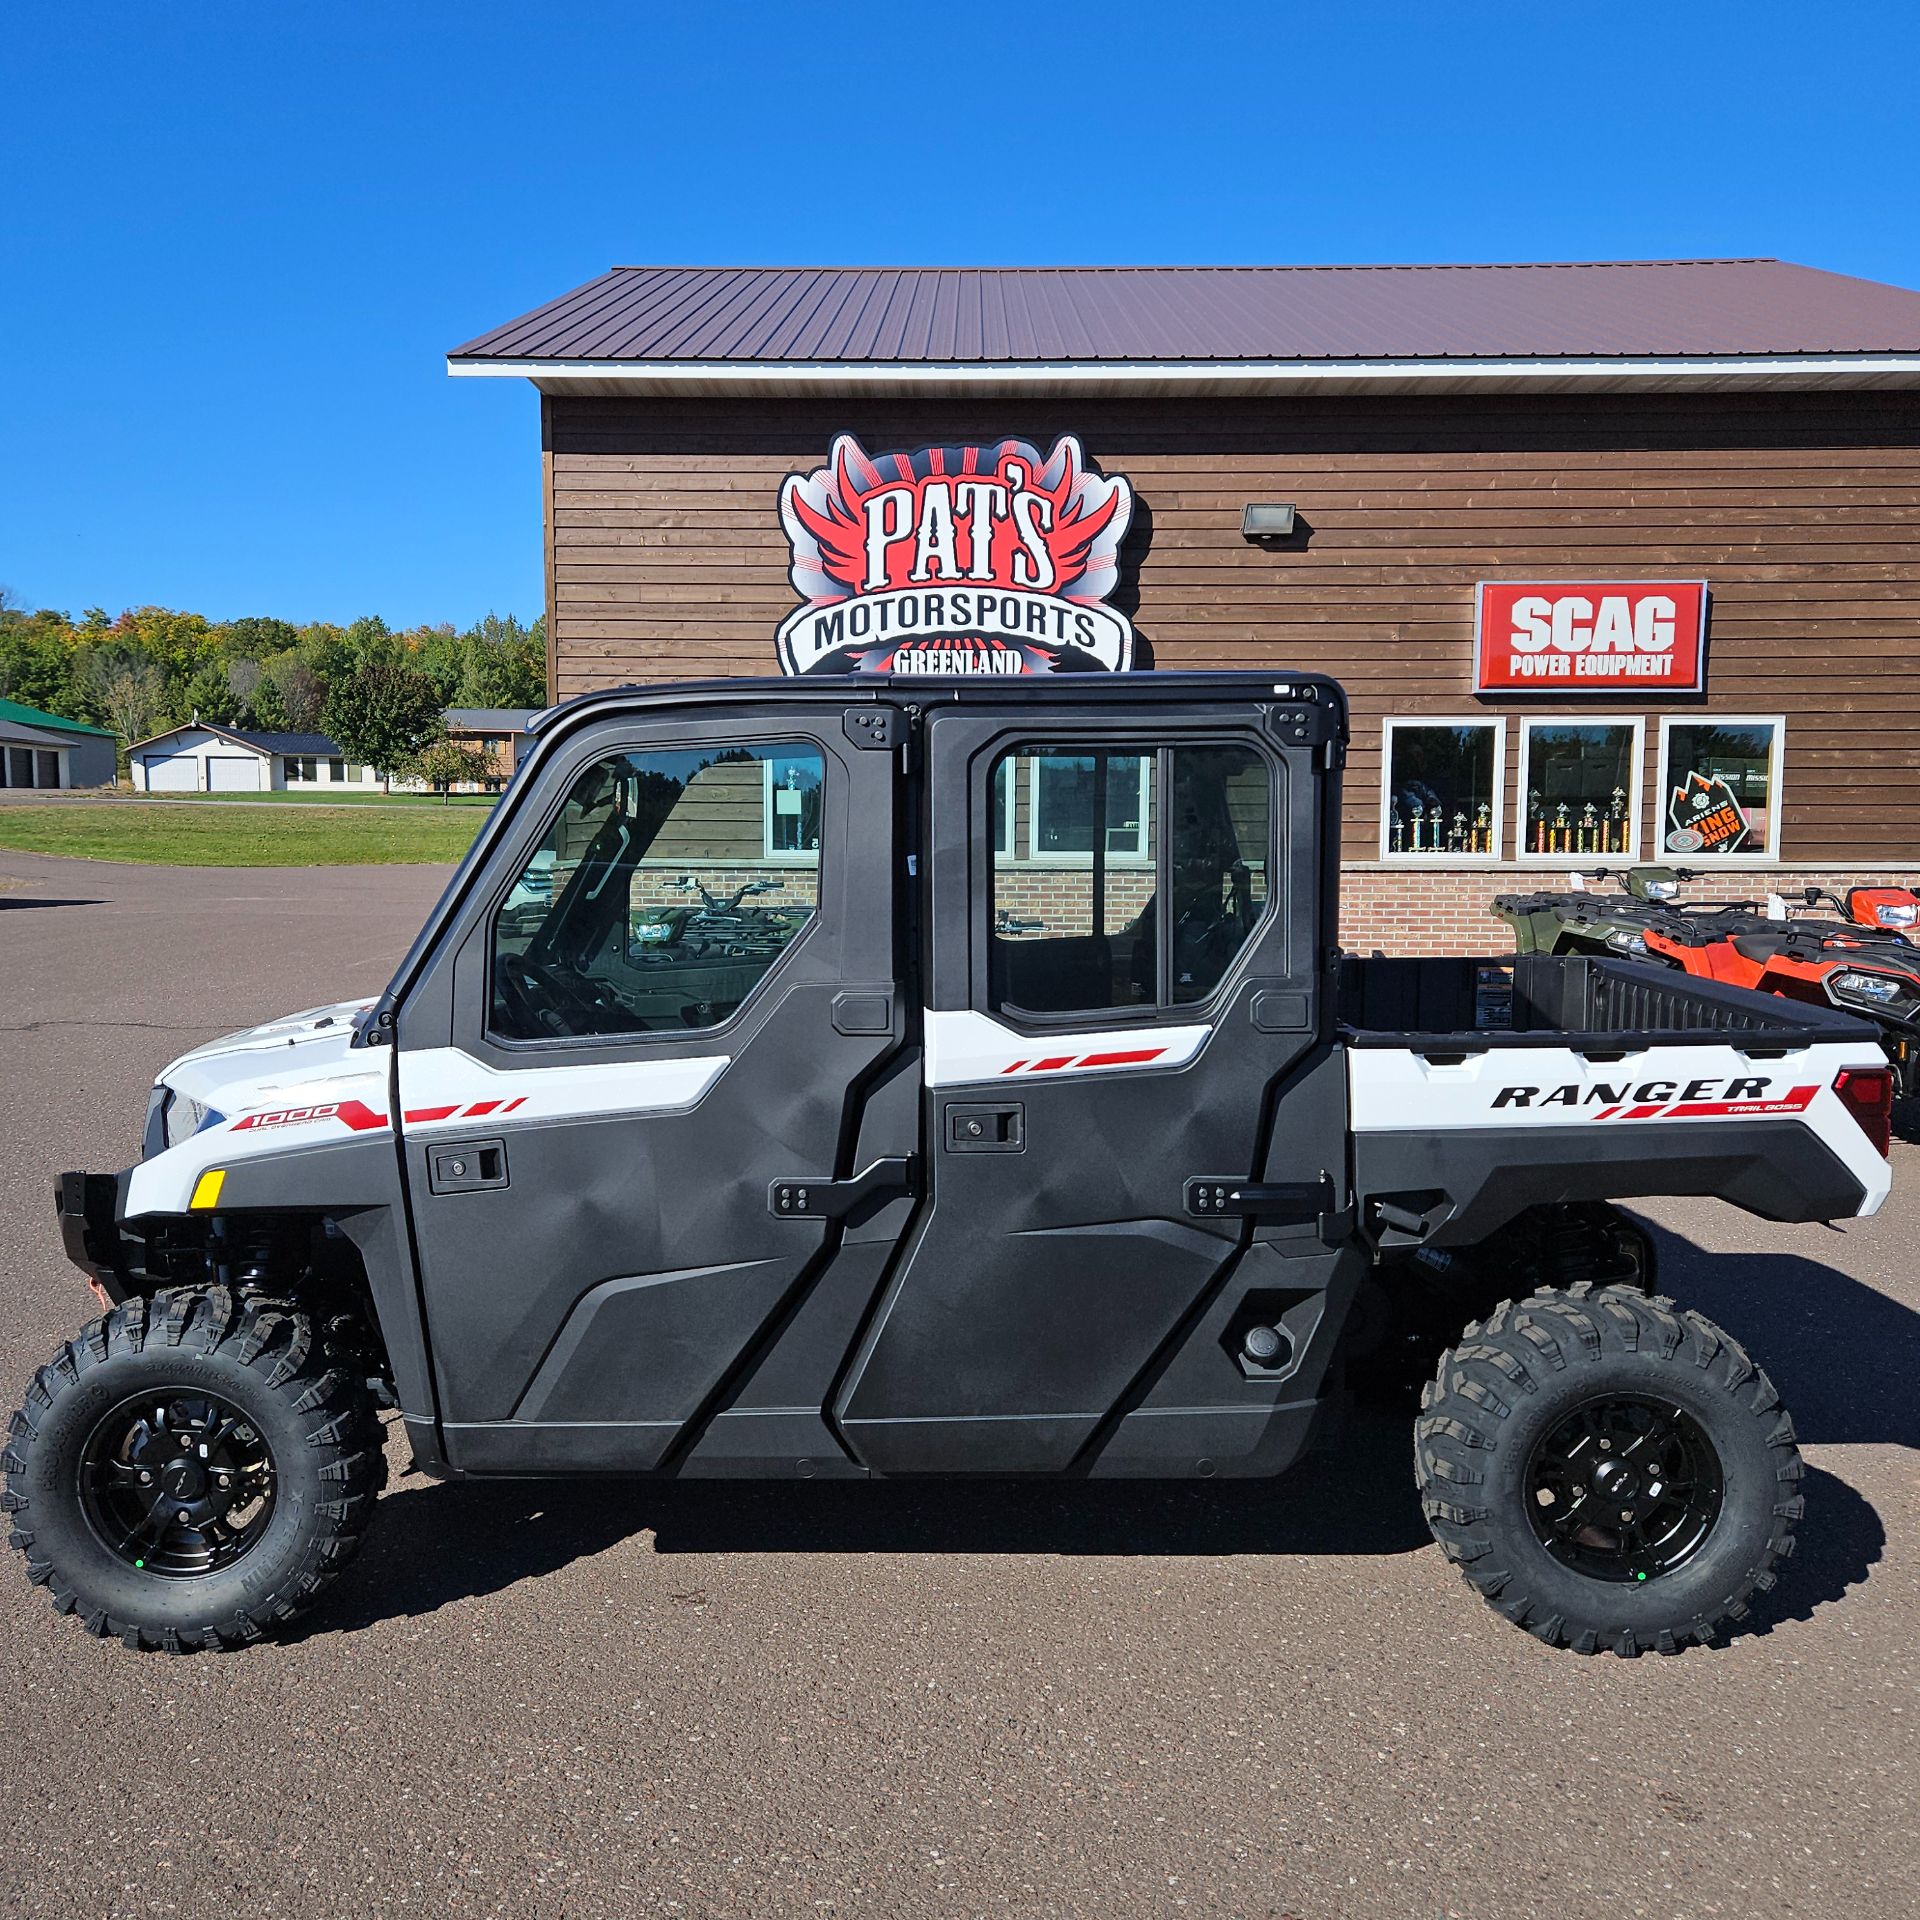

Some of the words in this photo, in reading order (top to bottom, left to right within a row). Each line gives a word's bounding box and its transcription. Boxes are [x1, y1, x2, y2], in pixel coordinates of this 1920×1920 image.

[862, 463, 1056, 592] PAT'S
[814, 594, 1097, 651] MOTORSPORTS
[1510, 595, 1677, 653] SCAG
[895, 648, 1021, 674] GREENLAND
[1509, 654, 1571, 677] POWER
[1574, 653, 1674, 676] EQUIPMENT
[1685, 799, 1729, 827] ARIENS
[1702, 819, 1741, 848] SNOW
[1490, 1076, 1773, 1109] RANGER
[1727, 1101, 1763, 1112] TRAIL
[1764, 1099, 1803, 1110] BOSS
[250, 1104, 340, 1127] 1000
